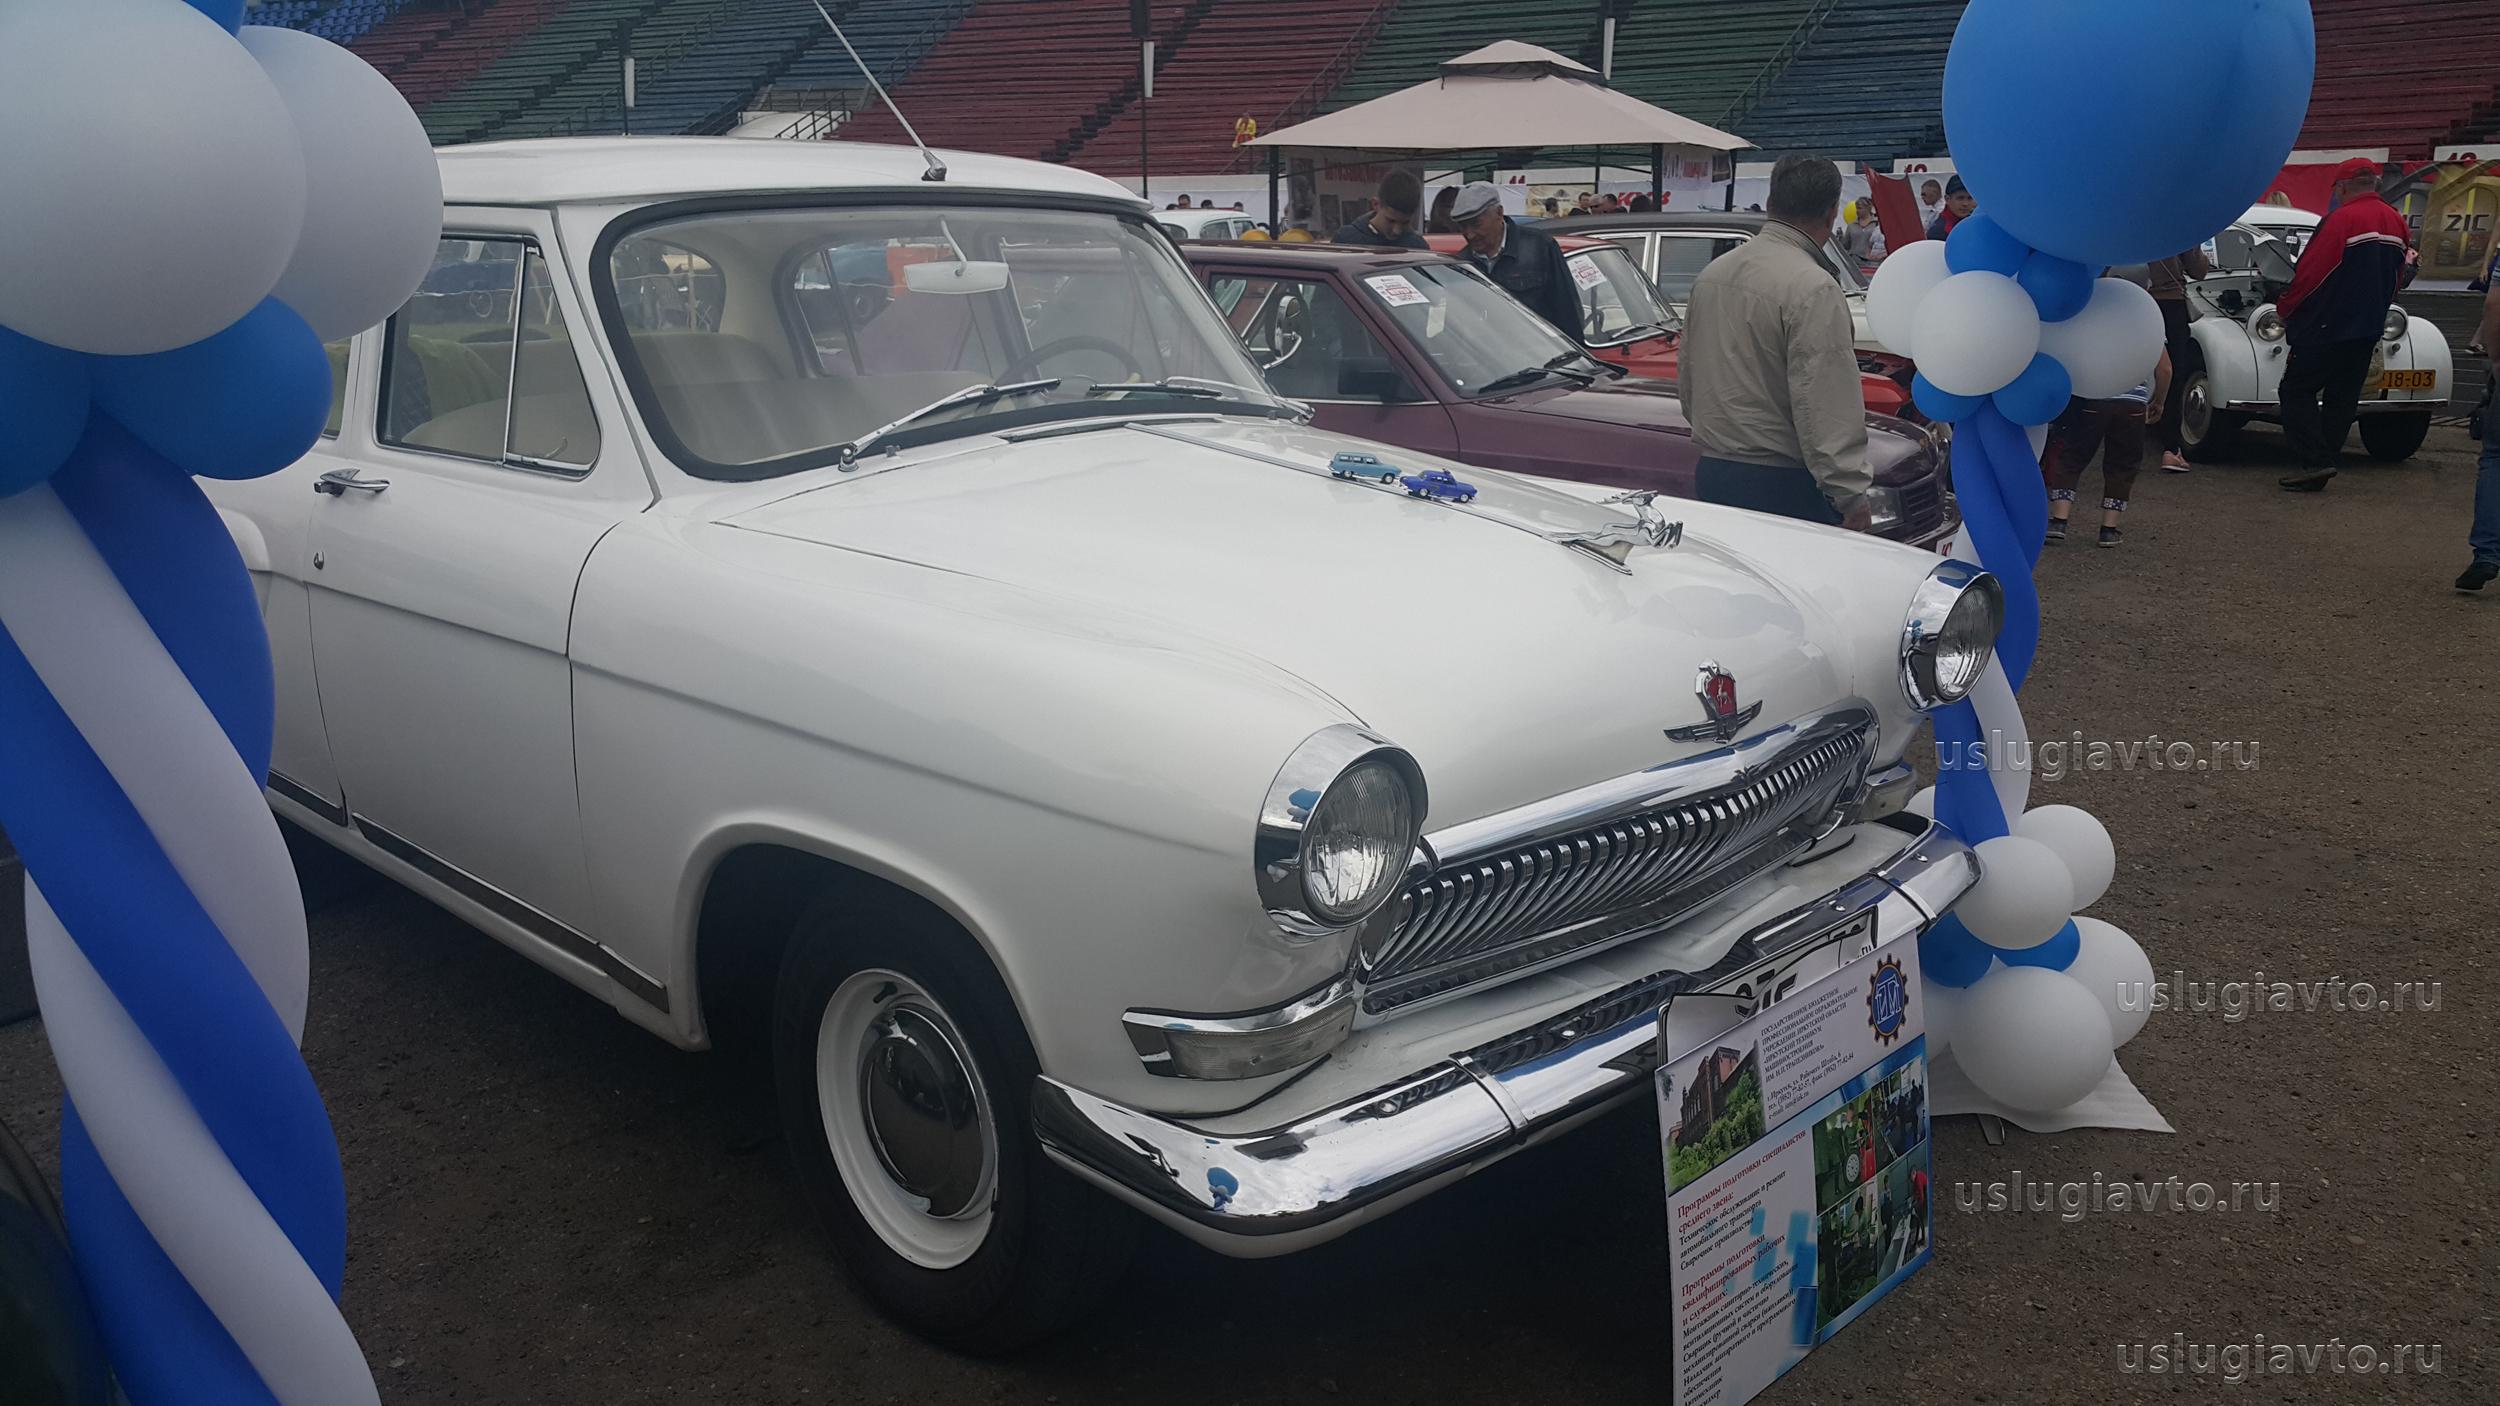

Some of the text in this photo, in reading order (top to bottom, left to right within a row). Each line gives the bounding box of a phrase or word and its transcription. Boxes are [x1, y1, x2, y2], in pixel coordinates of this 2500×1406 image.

[2444, 214, 2489, 231] ZIC
[1677, 1130, 1805, 1218] Программы подготовки специалистов
[1678, 1208, 1711, 1234] среднего
[1681, 1234, 1765, 1296] Программы подготовки
